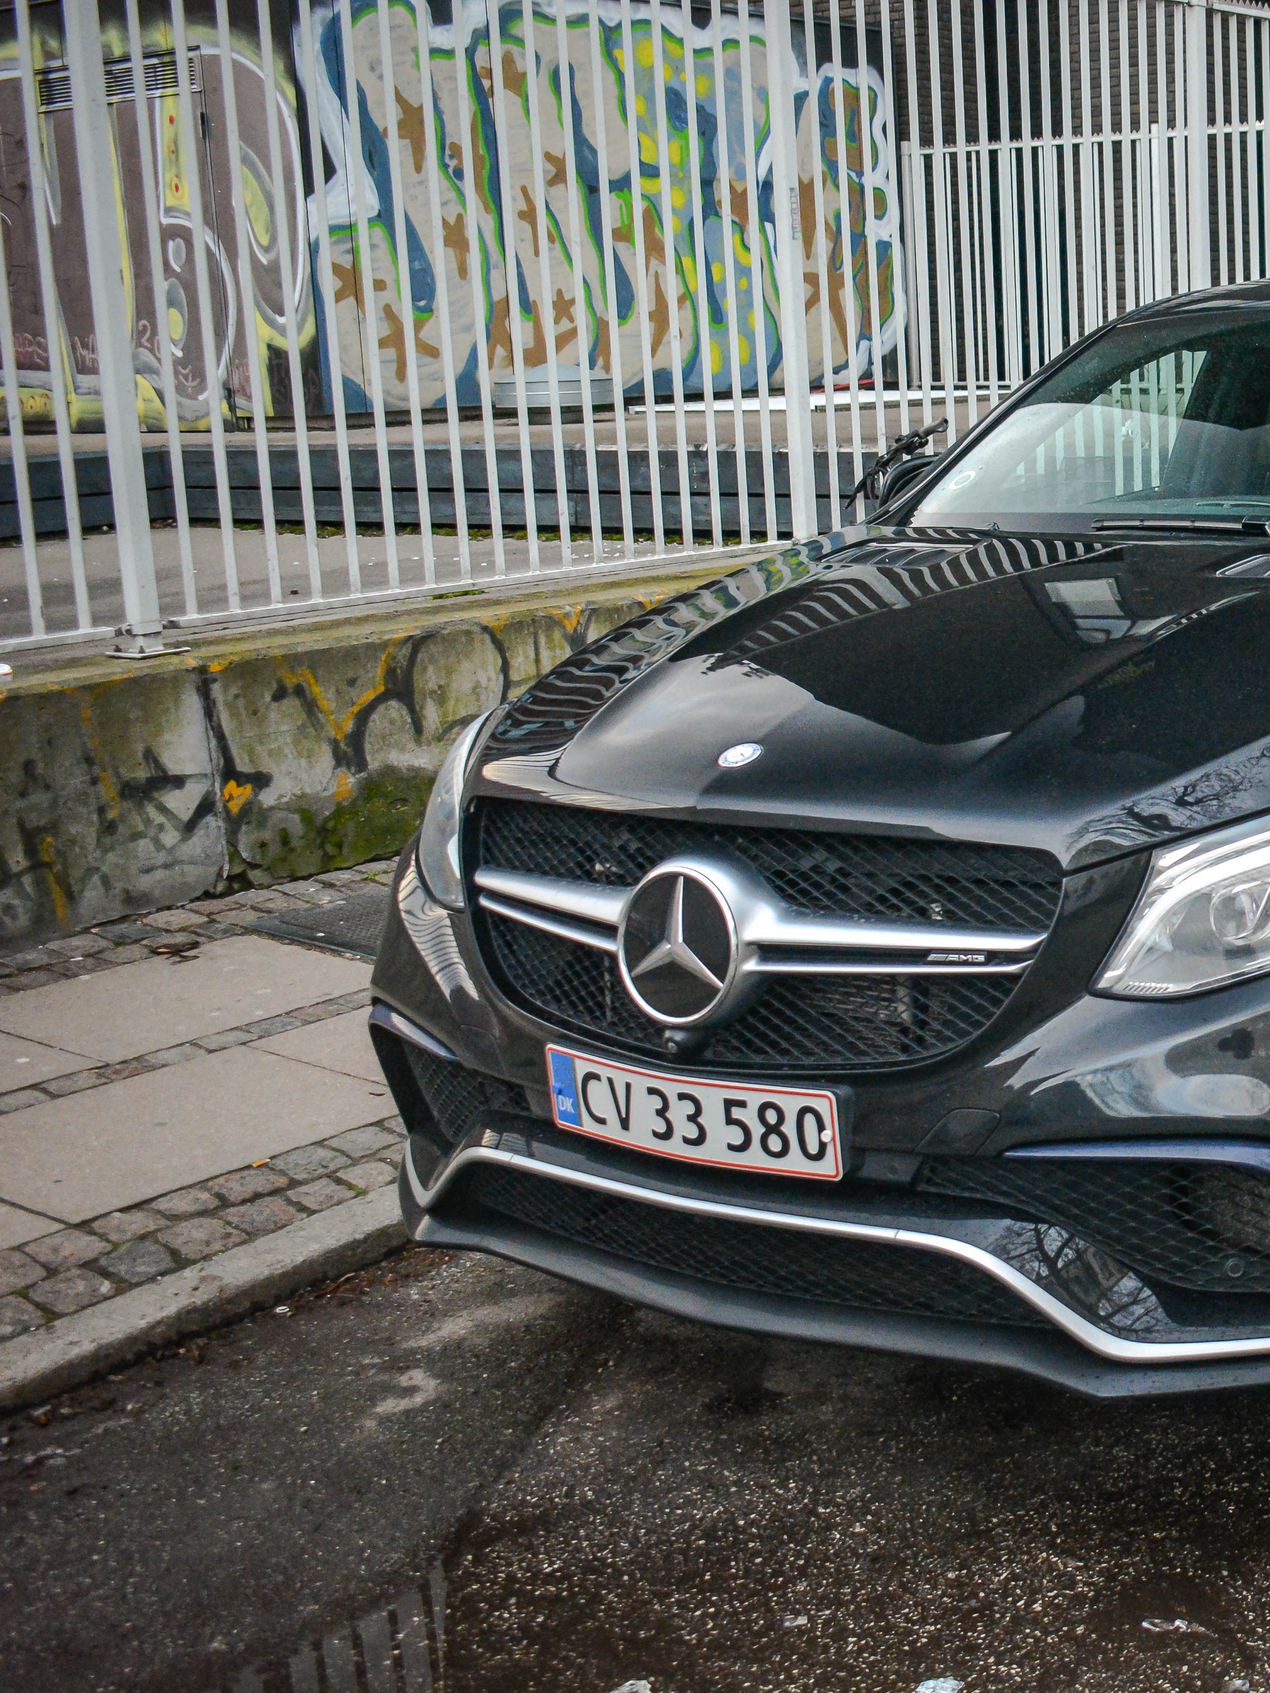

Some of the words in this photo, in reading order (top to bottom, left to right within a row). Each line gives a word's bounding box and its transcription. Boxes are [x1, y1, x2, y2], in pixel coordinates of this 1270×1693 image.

[945, 954, 985, 962] AMG
[558, 1094, 575, 1113] DK
[581, 1070, 632, 1131] CV
[647, 1085, 707, 1147] 33
[723, 1097, 828, 1162] 580
